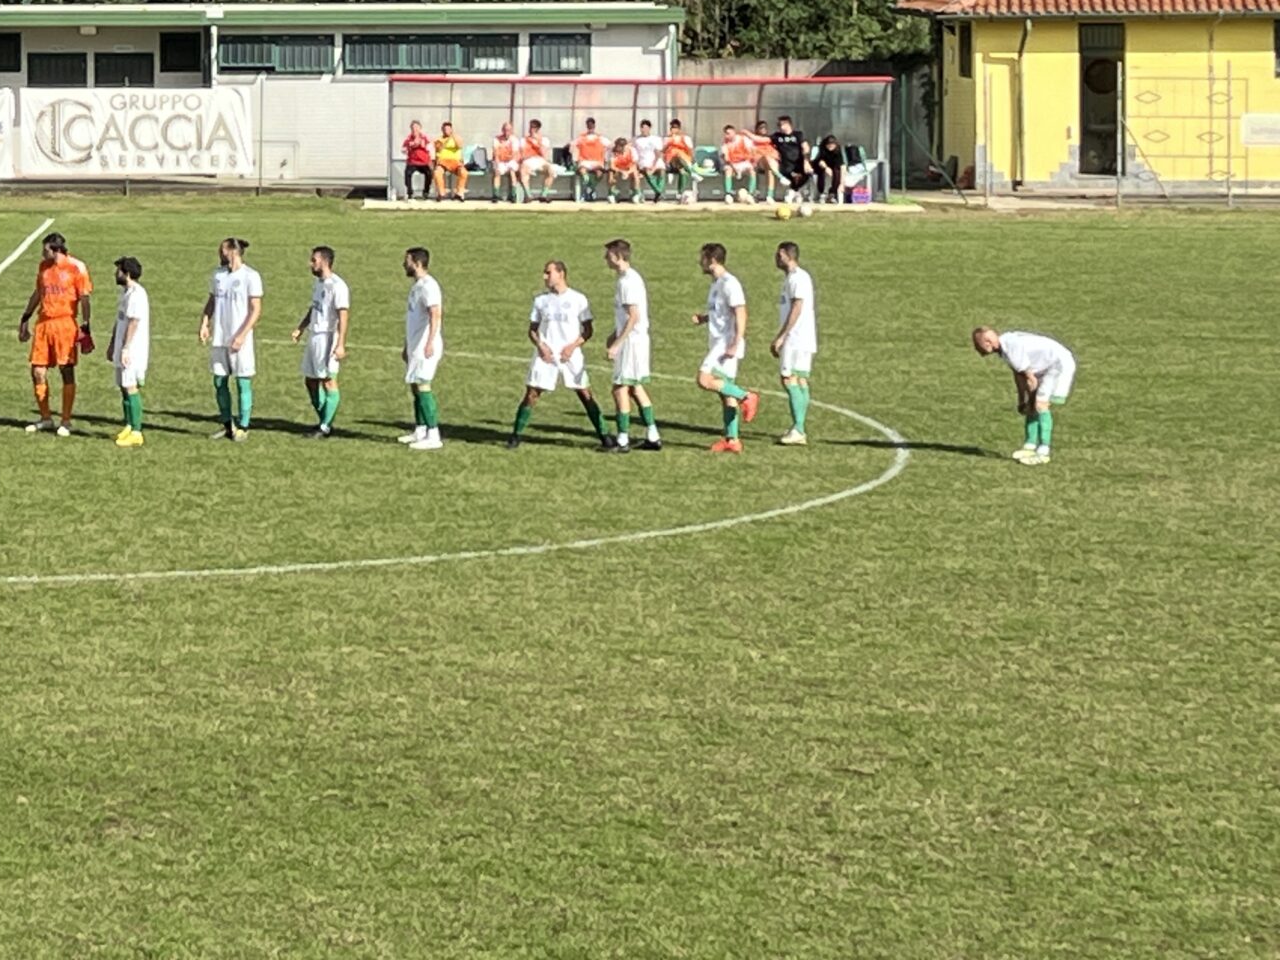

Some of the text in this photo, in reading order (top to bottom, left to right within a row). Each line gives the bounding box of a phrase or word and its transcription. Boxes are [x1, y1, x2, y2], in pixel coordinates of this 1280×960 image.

[109, 93, 203, 111] GRUPPO
[62, 111, 238, 152] CACCIA
[99, 154, 238, 168] SERVICES
